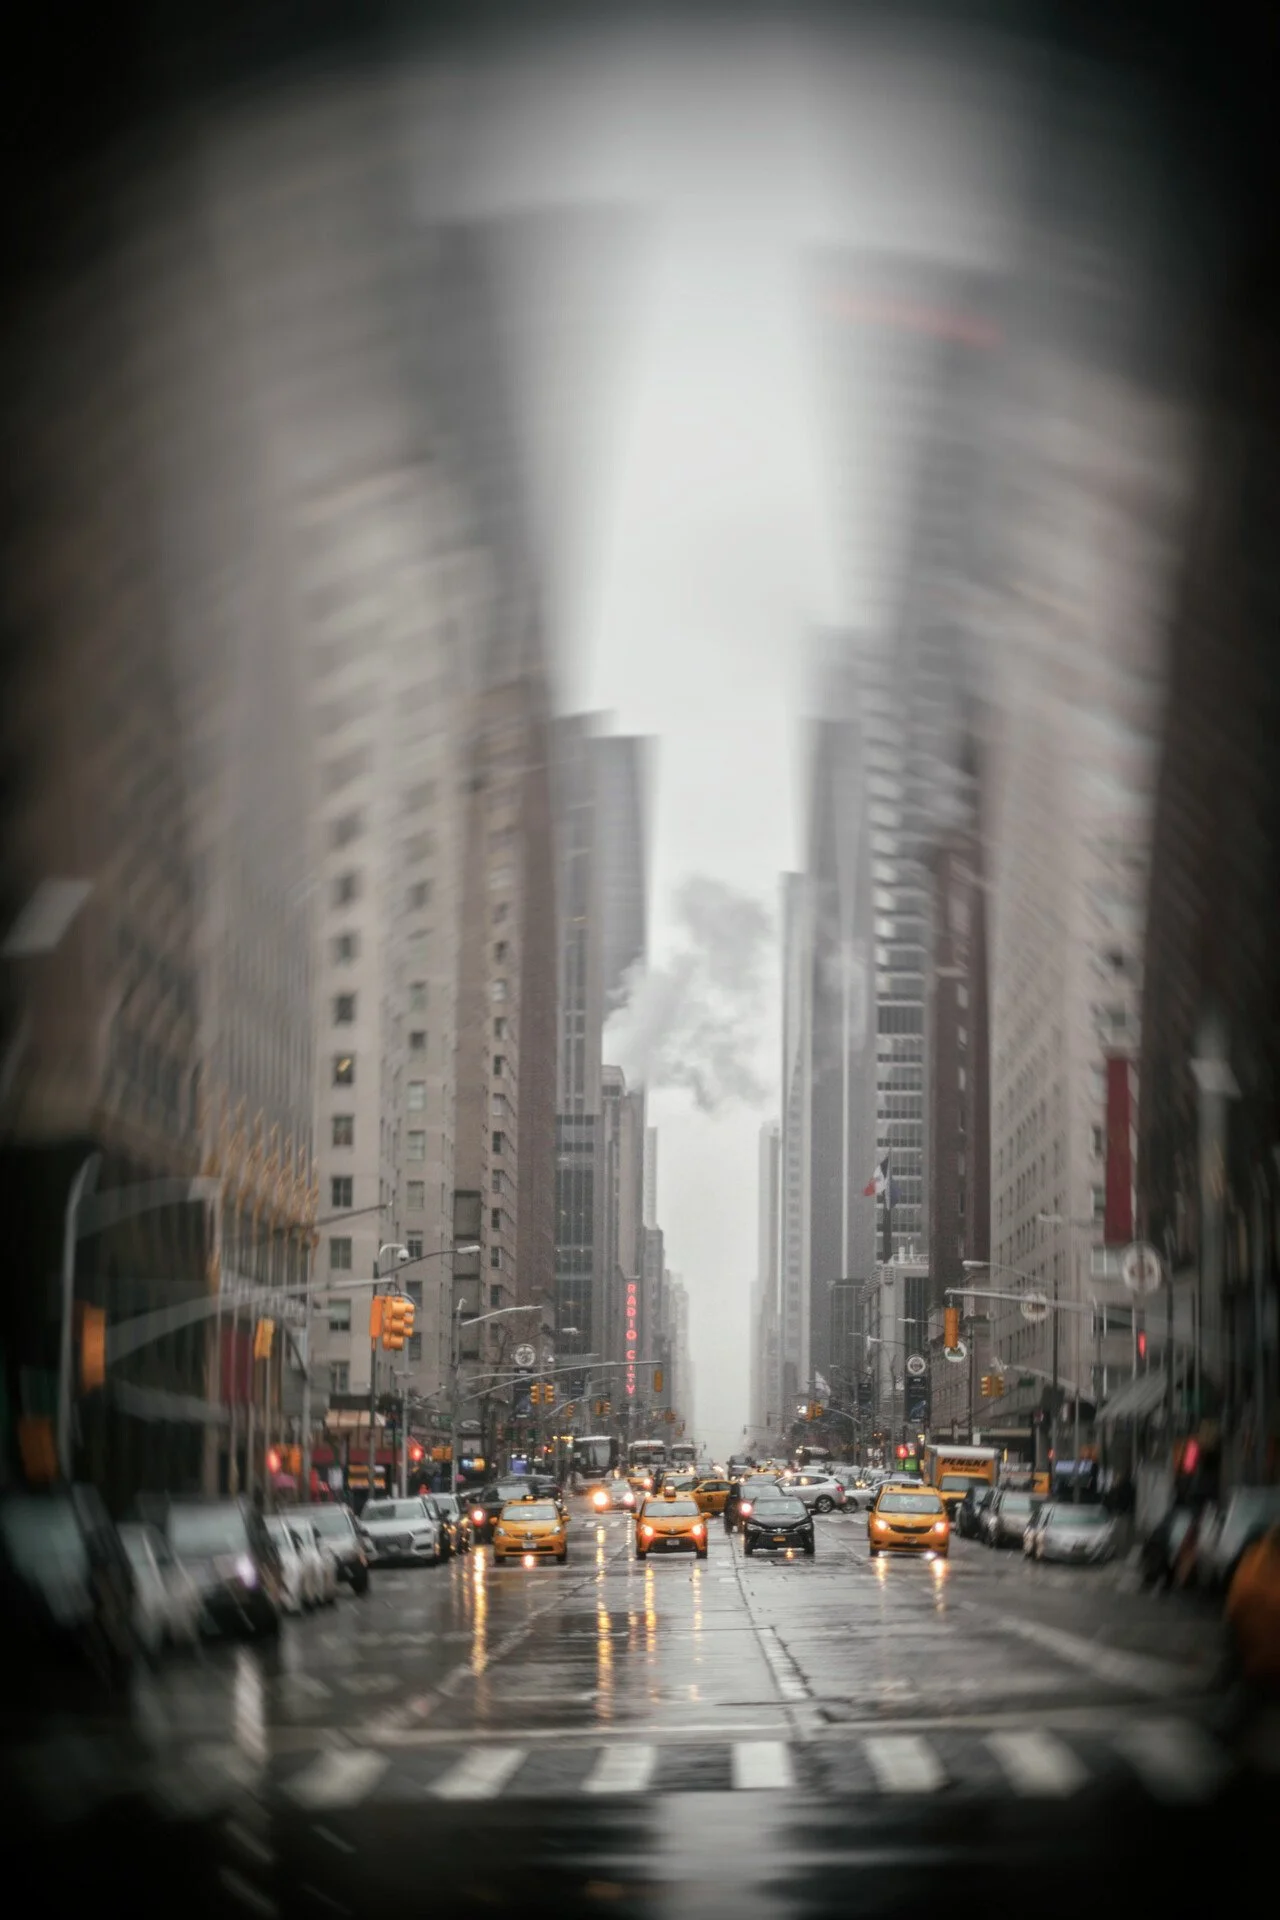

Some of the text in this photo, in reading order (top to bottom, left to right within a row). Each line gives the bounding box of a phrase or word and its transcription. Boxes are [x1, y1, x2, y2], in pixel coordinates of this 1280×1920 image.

[626, 1283, 637, 1394] RADIO CITY
[941, 1457, 989, 1467] PENSKE
